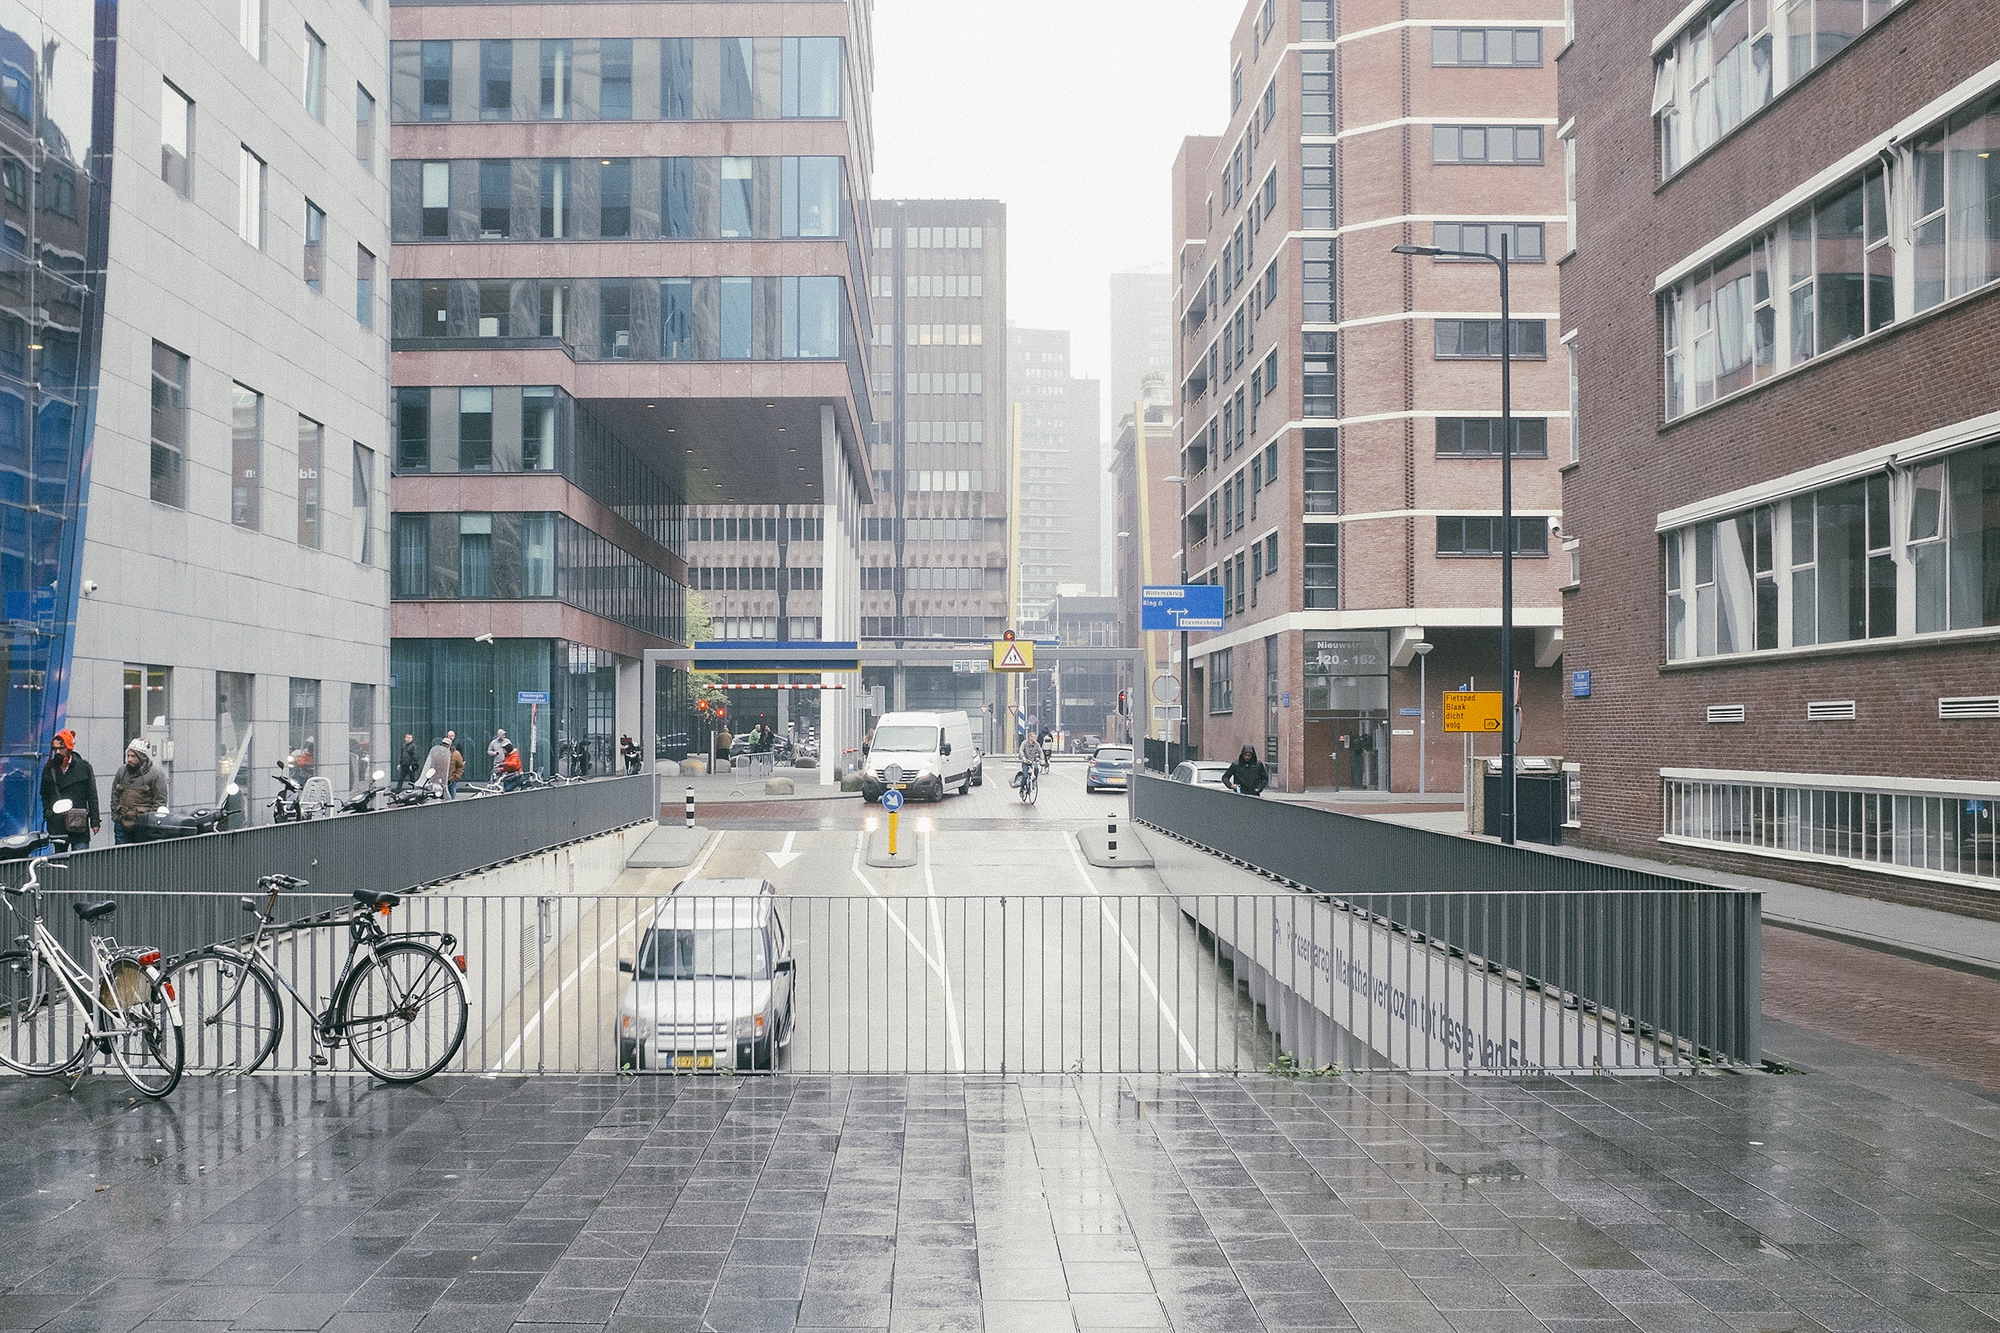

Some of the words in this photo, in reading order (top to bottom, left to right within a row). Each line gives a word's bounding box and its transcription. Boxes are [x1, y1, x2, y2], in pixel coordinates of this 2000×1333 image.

[1317, 641, 1369, 649] Nieuwstra
[1315, 654, 1340, 665] 120
[1446, 703, 1466, 711] Blaak
[1446, 722, 1461, 730] volg
[1336, 947, 1370, 998] Matha
[1372, 976, 1418, 1028] verozn
[1439, 1002, 1474, 1061] bese
